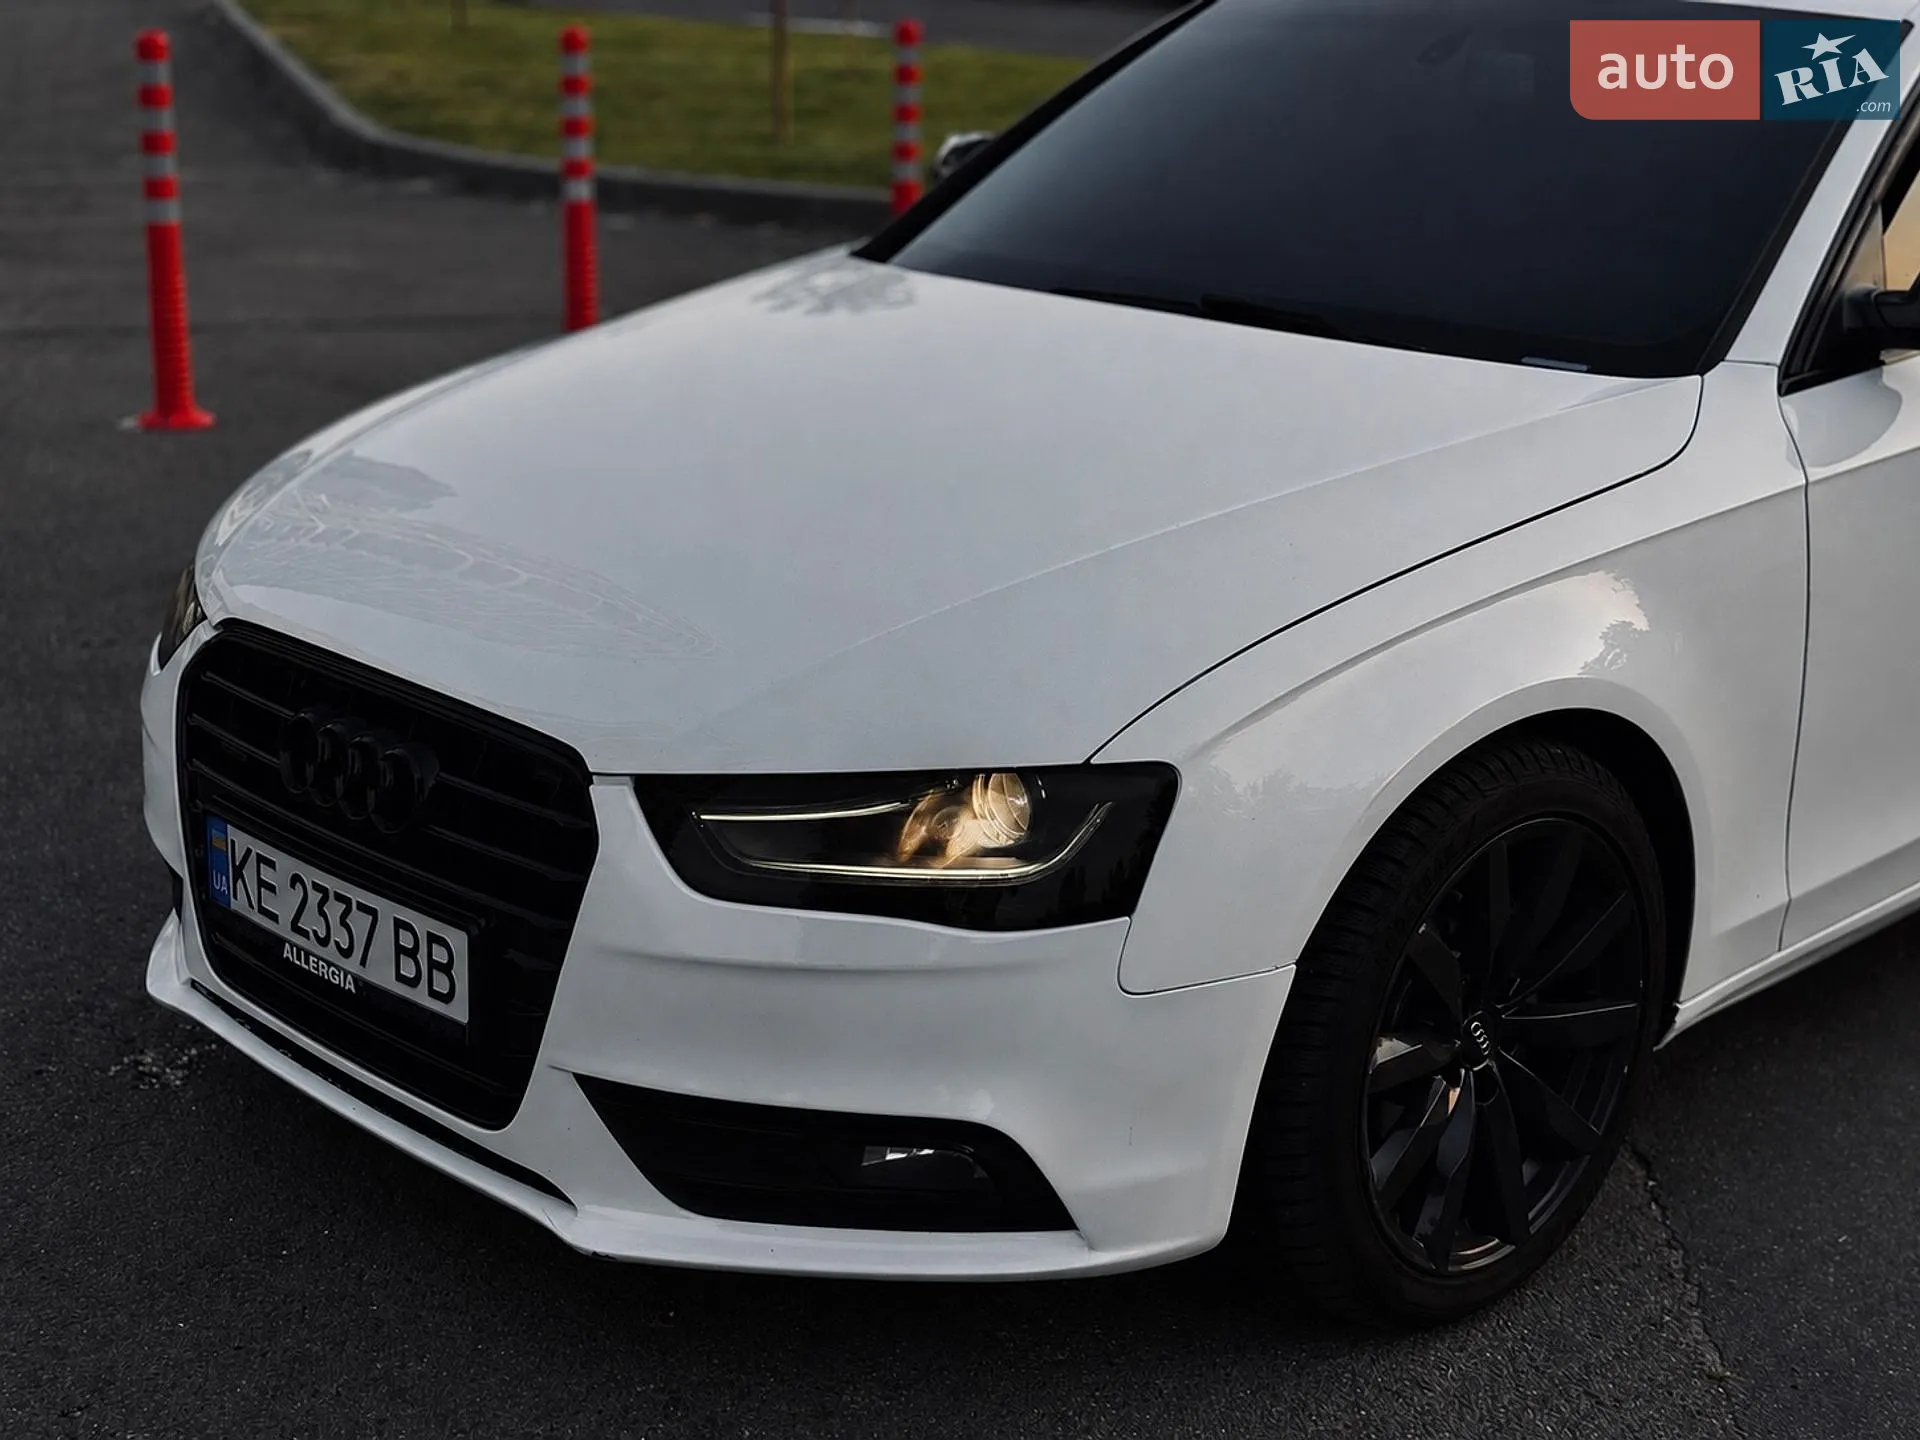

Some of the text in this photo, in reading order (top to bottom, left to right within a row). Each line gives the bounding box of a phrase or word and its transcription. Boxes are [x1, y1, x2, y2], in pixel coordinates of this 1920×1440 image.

[212, 872, 228, 895] UA
[230, 838, 456, 1005] KE 2337 BB
[283, 942, 356, 993] ALLERGIA
